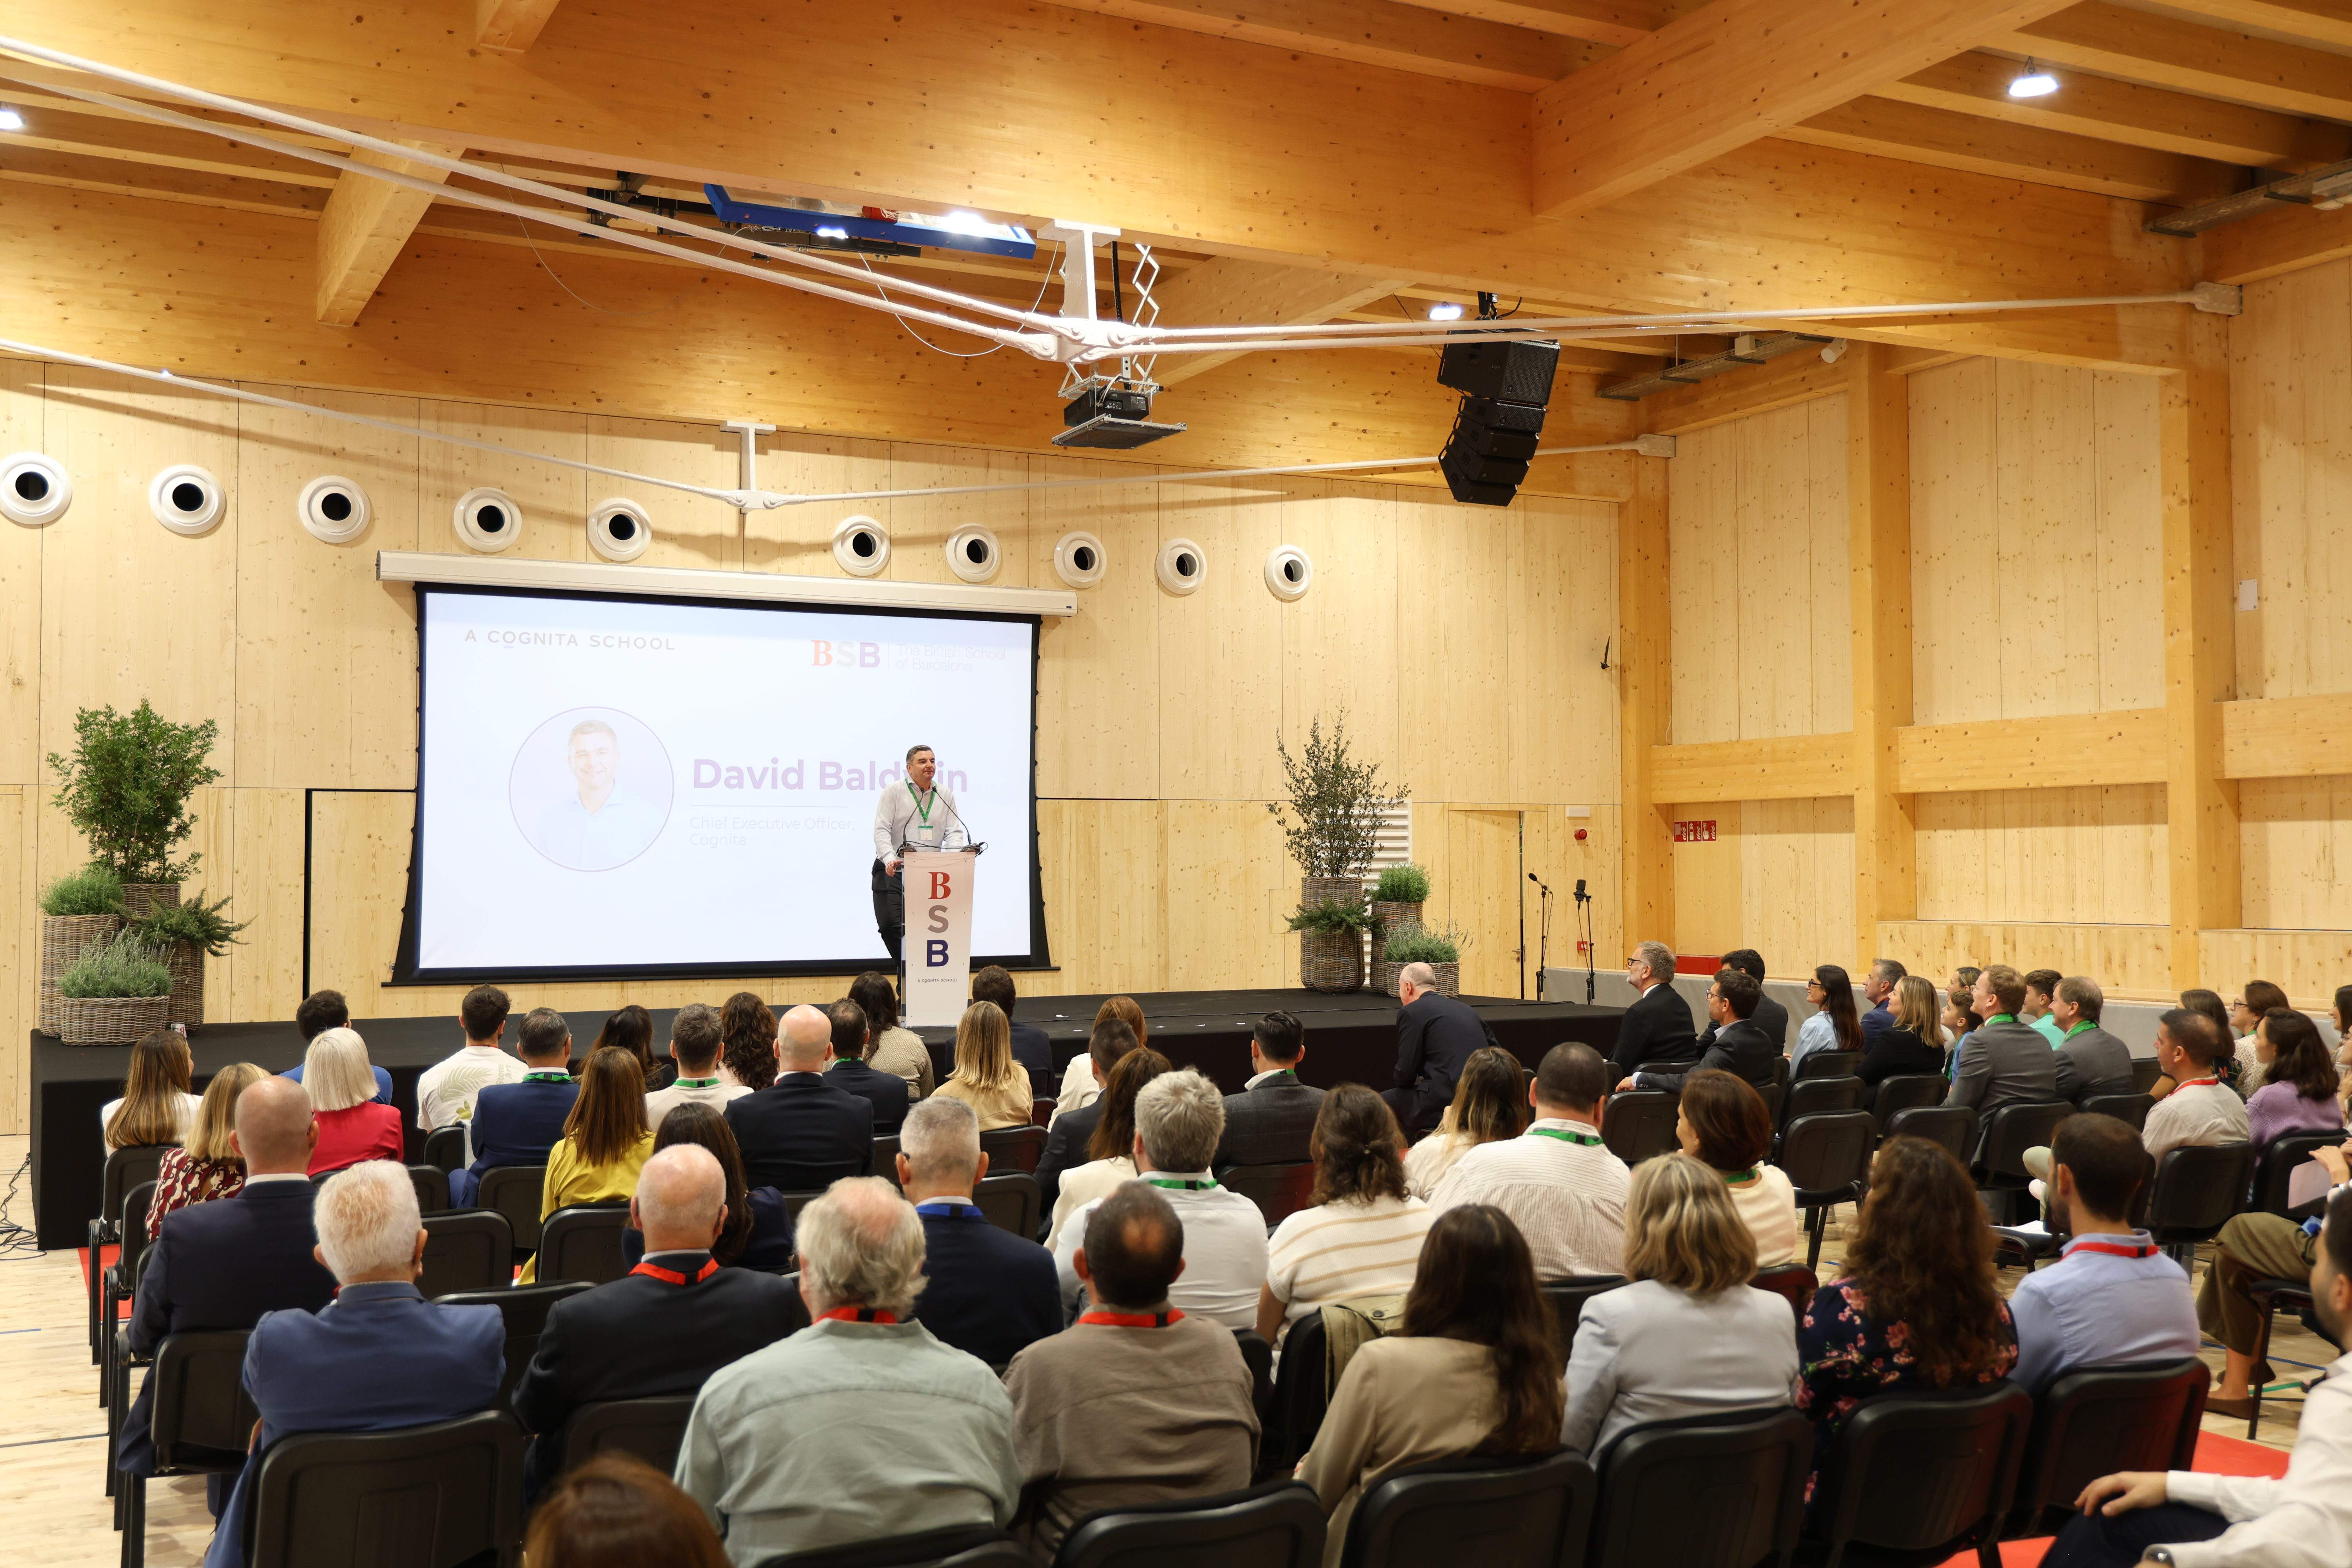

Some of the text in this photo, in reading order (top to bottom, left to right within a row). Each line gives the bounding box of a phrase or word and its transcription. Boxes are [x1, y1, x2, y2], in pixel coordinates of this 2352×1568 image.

[465, 630, 675, 650] A COGNITA SCHOOL
[811, 640, 880, 668] BSB
[897, 644, 1006, 660] The British School
[897, 658, 973, 672] of Barcelona
[693, 757, 967, 792] David Baldin
[690, 817, 855, 831] Chief Executive Officer,
[690, 833, 746, 848] Cognita
